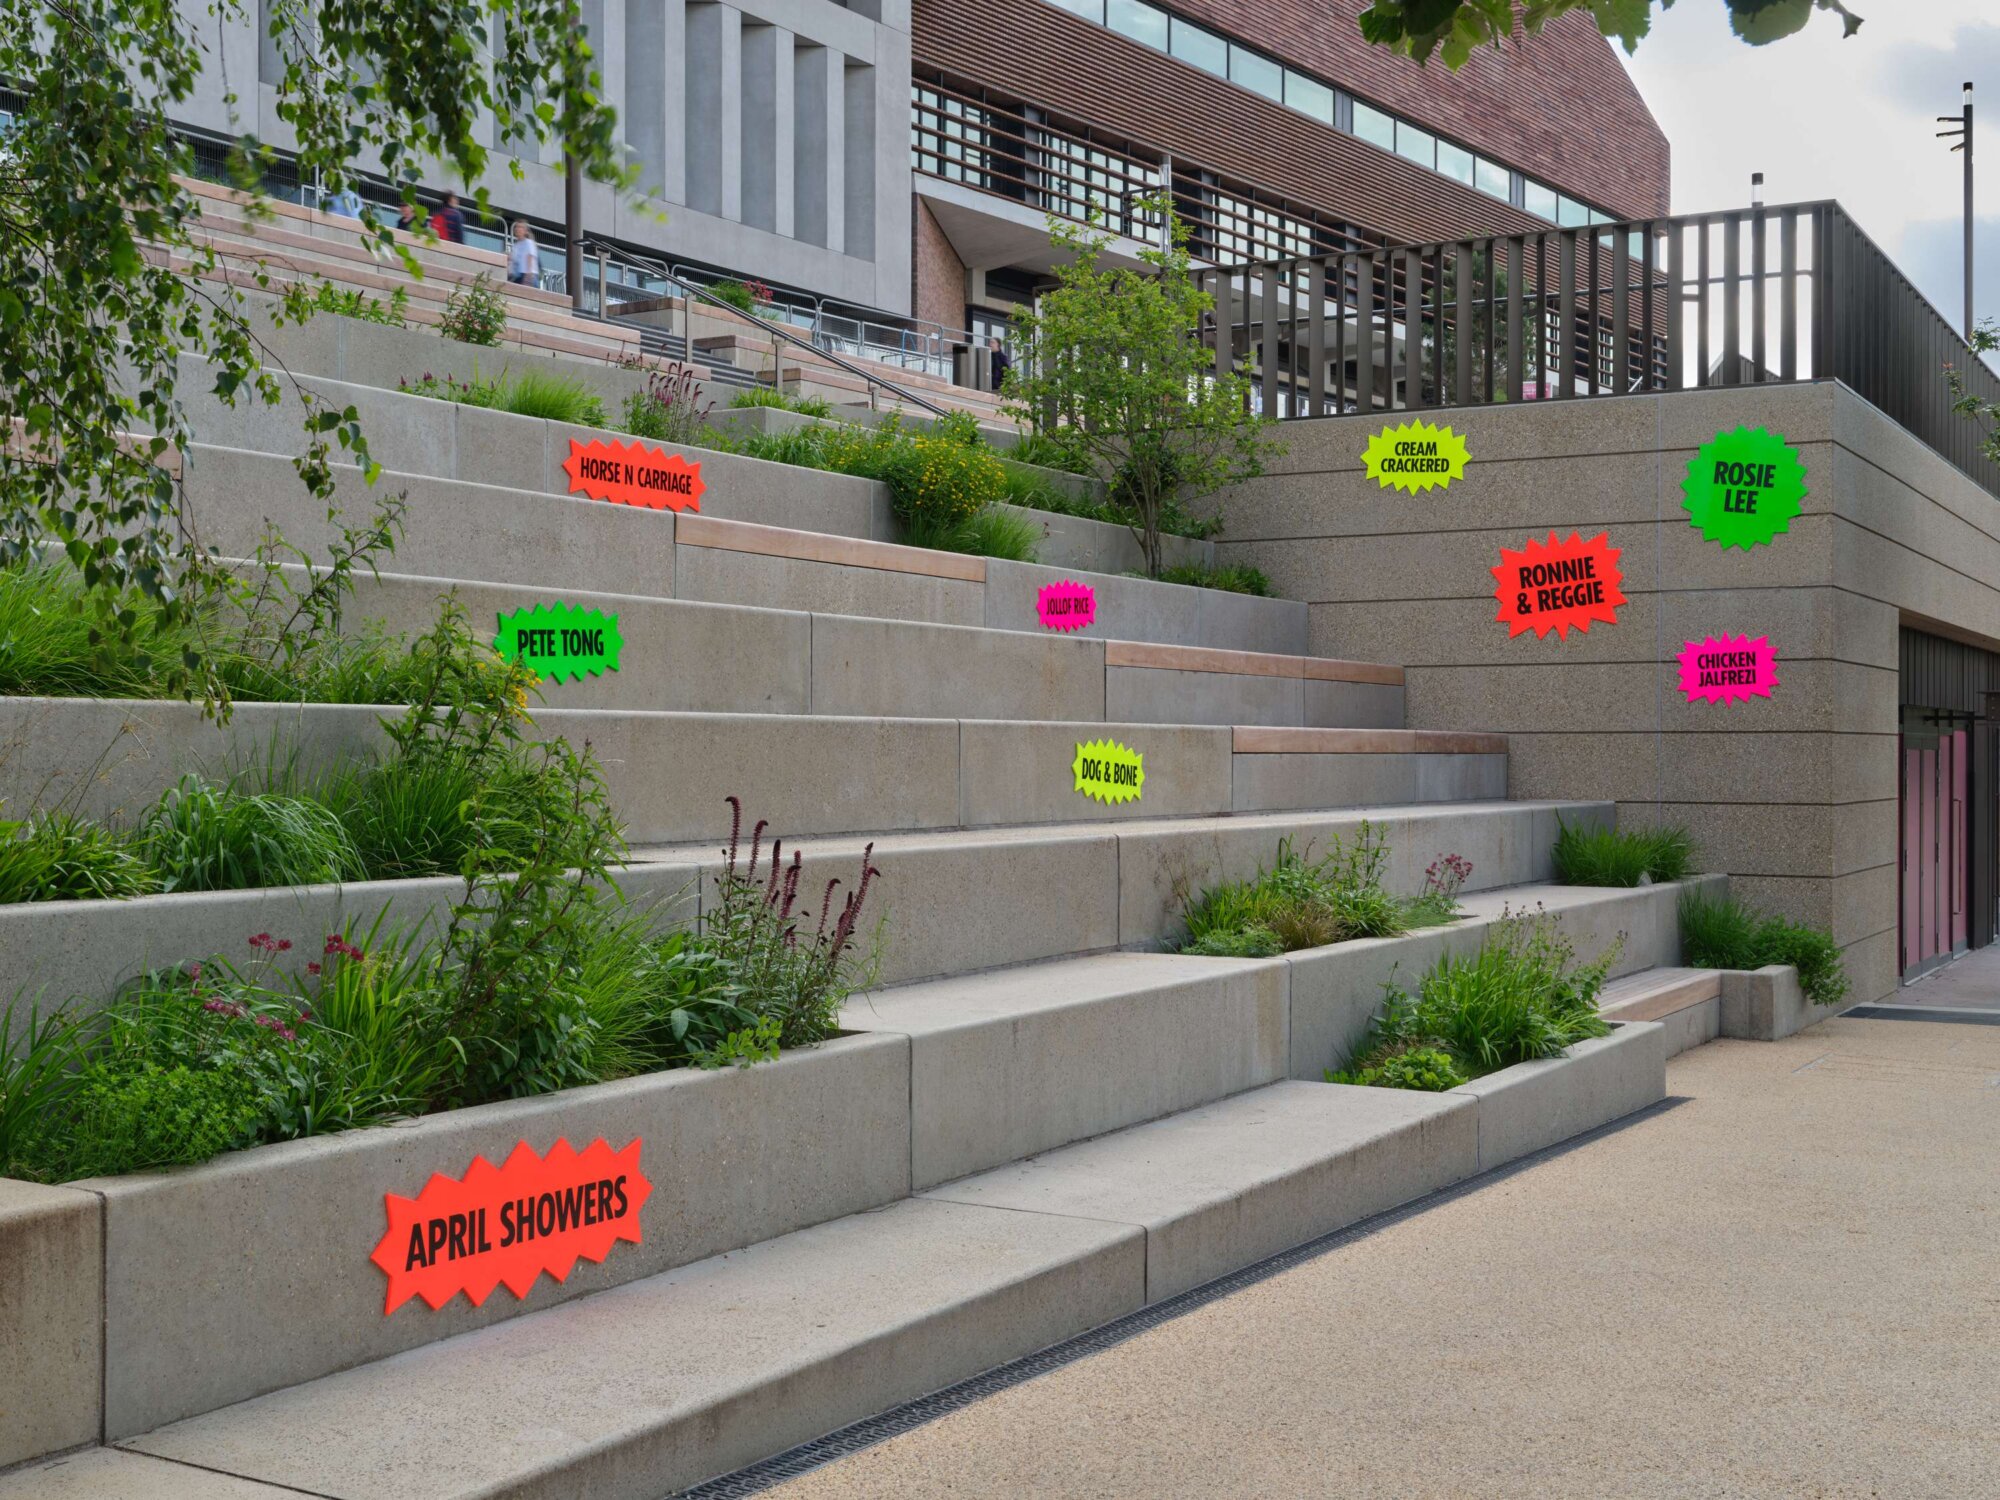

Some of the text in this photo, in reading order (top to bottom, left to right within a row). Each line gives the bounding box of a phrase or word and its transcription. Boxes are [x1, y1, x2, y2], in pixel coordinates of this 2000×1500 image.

[1395, 442, 1437, 456] CREAM
[580, 456, 692, 495] HORSE N CARRIAGE
[1381, 458, 1449, 472] CRACKERED
[1713, 461, 1776, 489] ROSIE
[1723, 488, 1759, 515] LEE
[1519, 556, 1596, 588] RONNIE
[1047, 597, 1089, 615] JOLLOF RICE
[1516, 581, 1605, 615] & REGGIE
[517, 628, 604, 657] PETE TONG
[1697, 652, 1756, 669] CHICKEN
[1698, 669, 1757, 687] JALFREZI
[1082, 757, 1138, 786] DOG & BONE
[405, 1175, 628, 1273] APRIL SHOWERS
